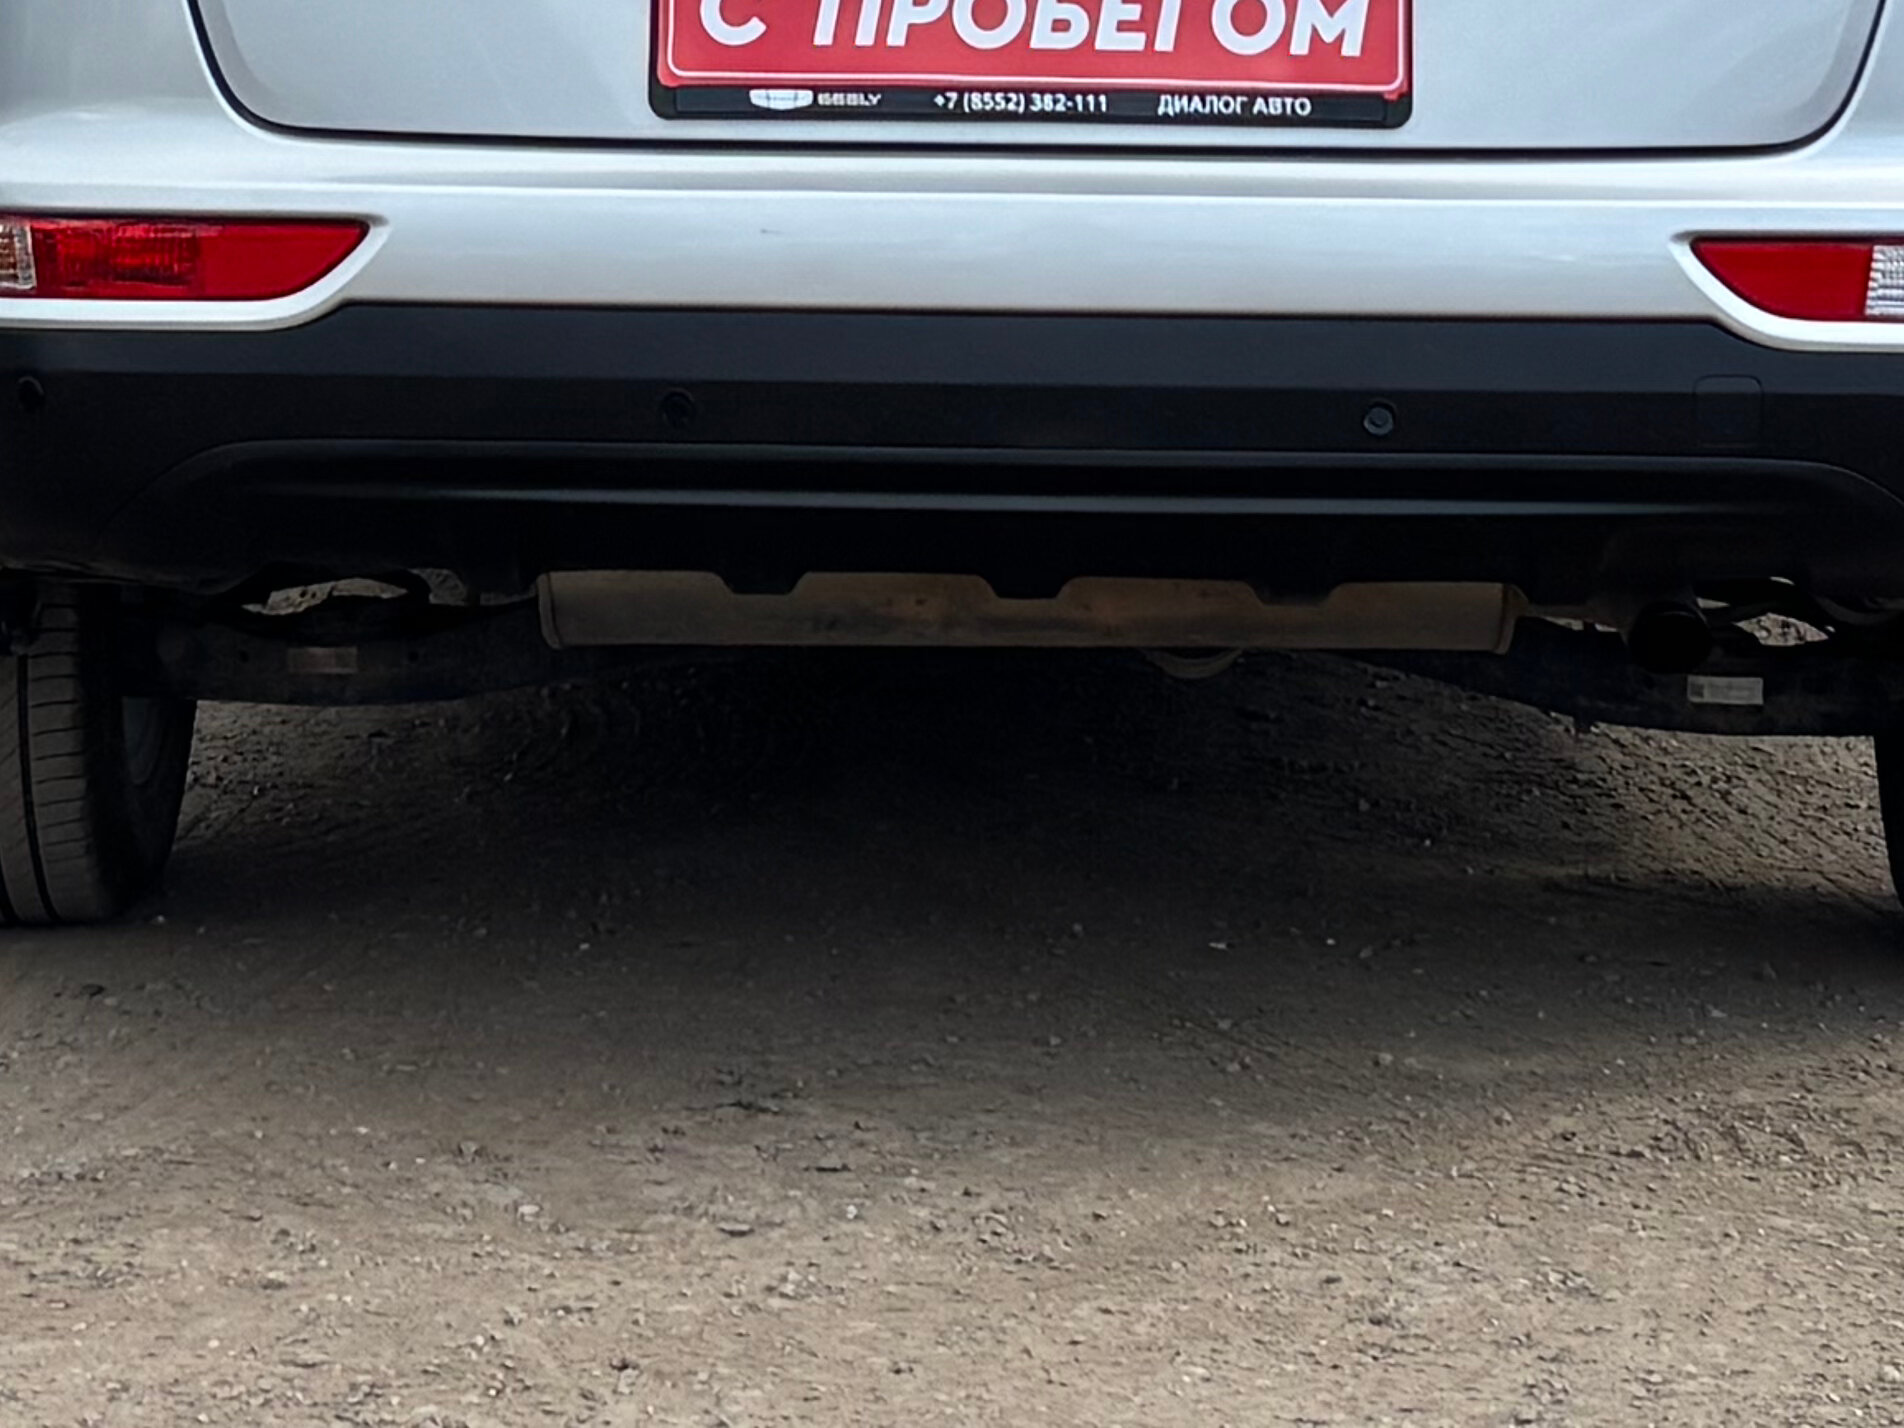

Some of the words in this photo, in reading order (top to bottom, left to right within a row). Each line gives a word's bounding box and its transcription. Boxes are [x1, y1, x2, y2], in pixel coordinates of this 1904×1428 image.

[933, 92, 958, 110] +7
[963, 91, 1026, 114] (8552)
[1029, 92, 1107, 113] 382-111
[1157, 94, 1249, 117] ДИАЛОГ
[1252, 96, 1312, 117] АВТО
